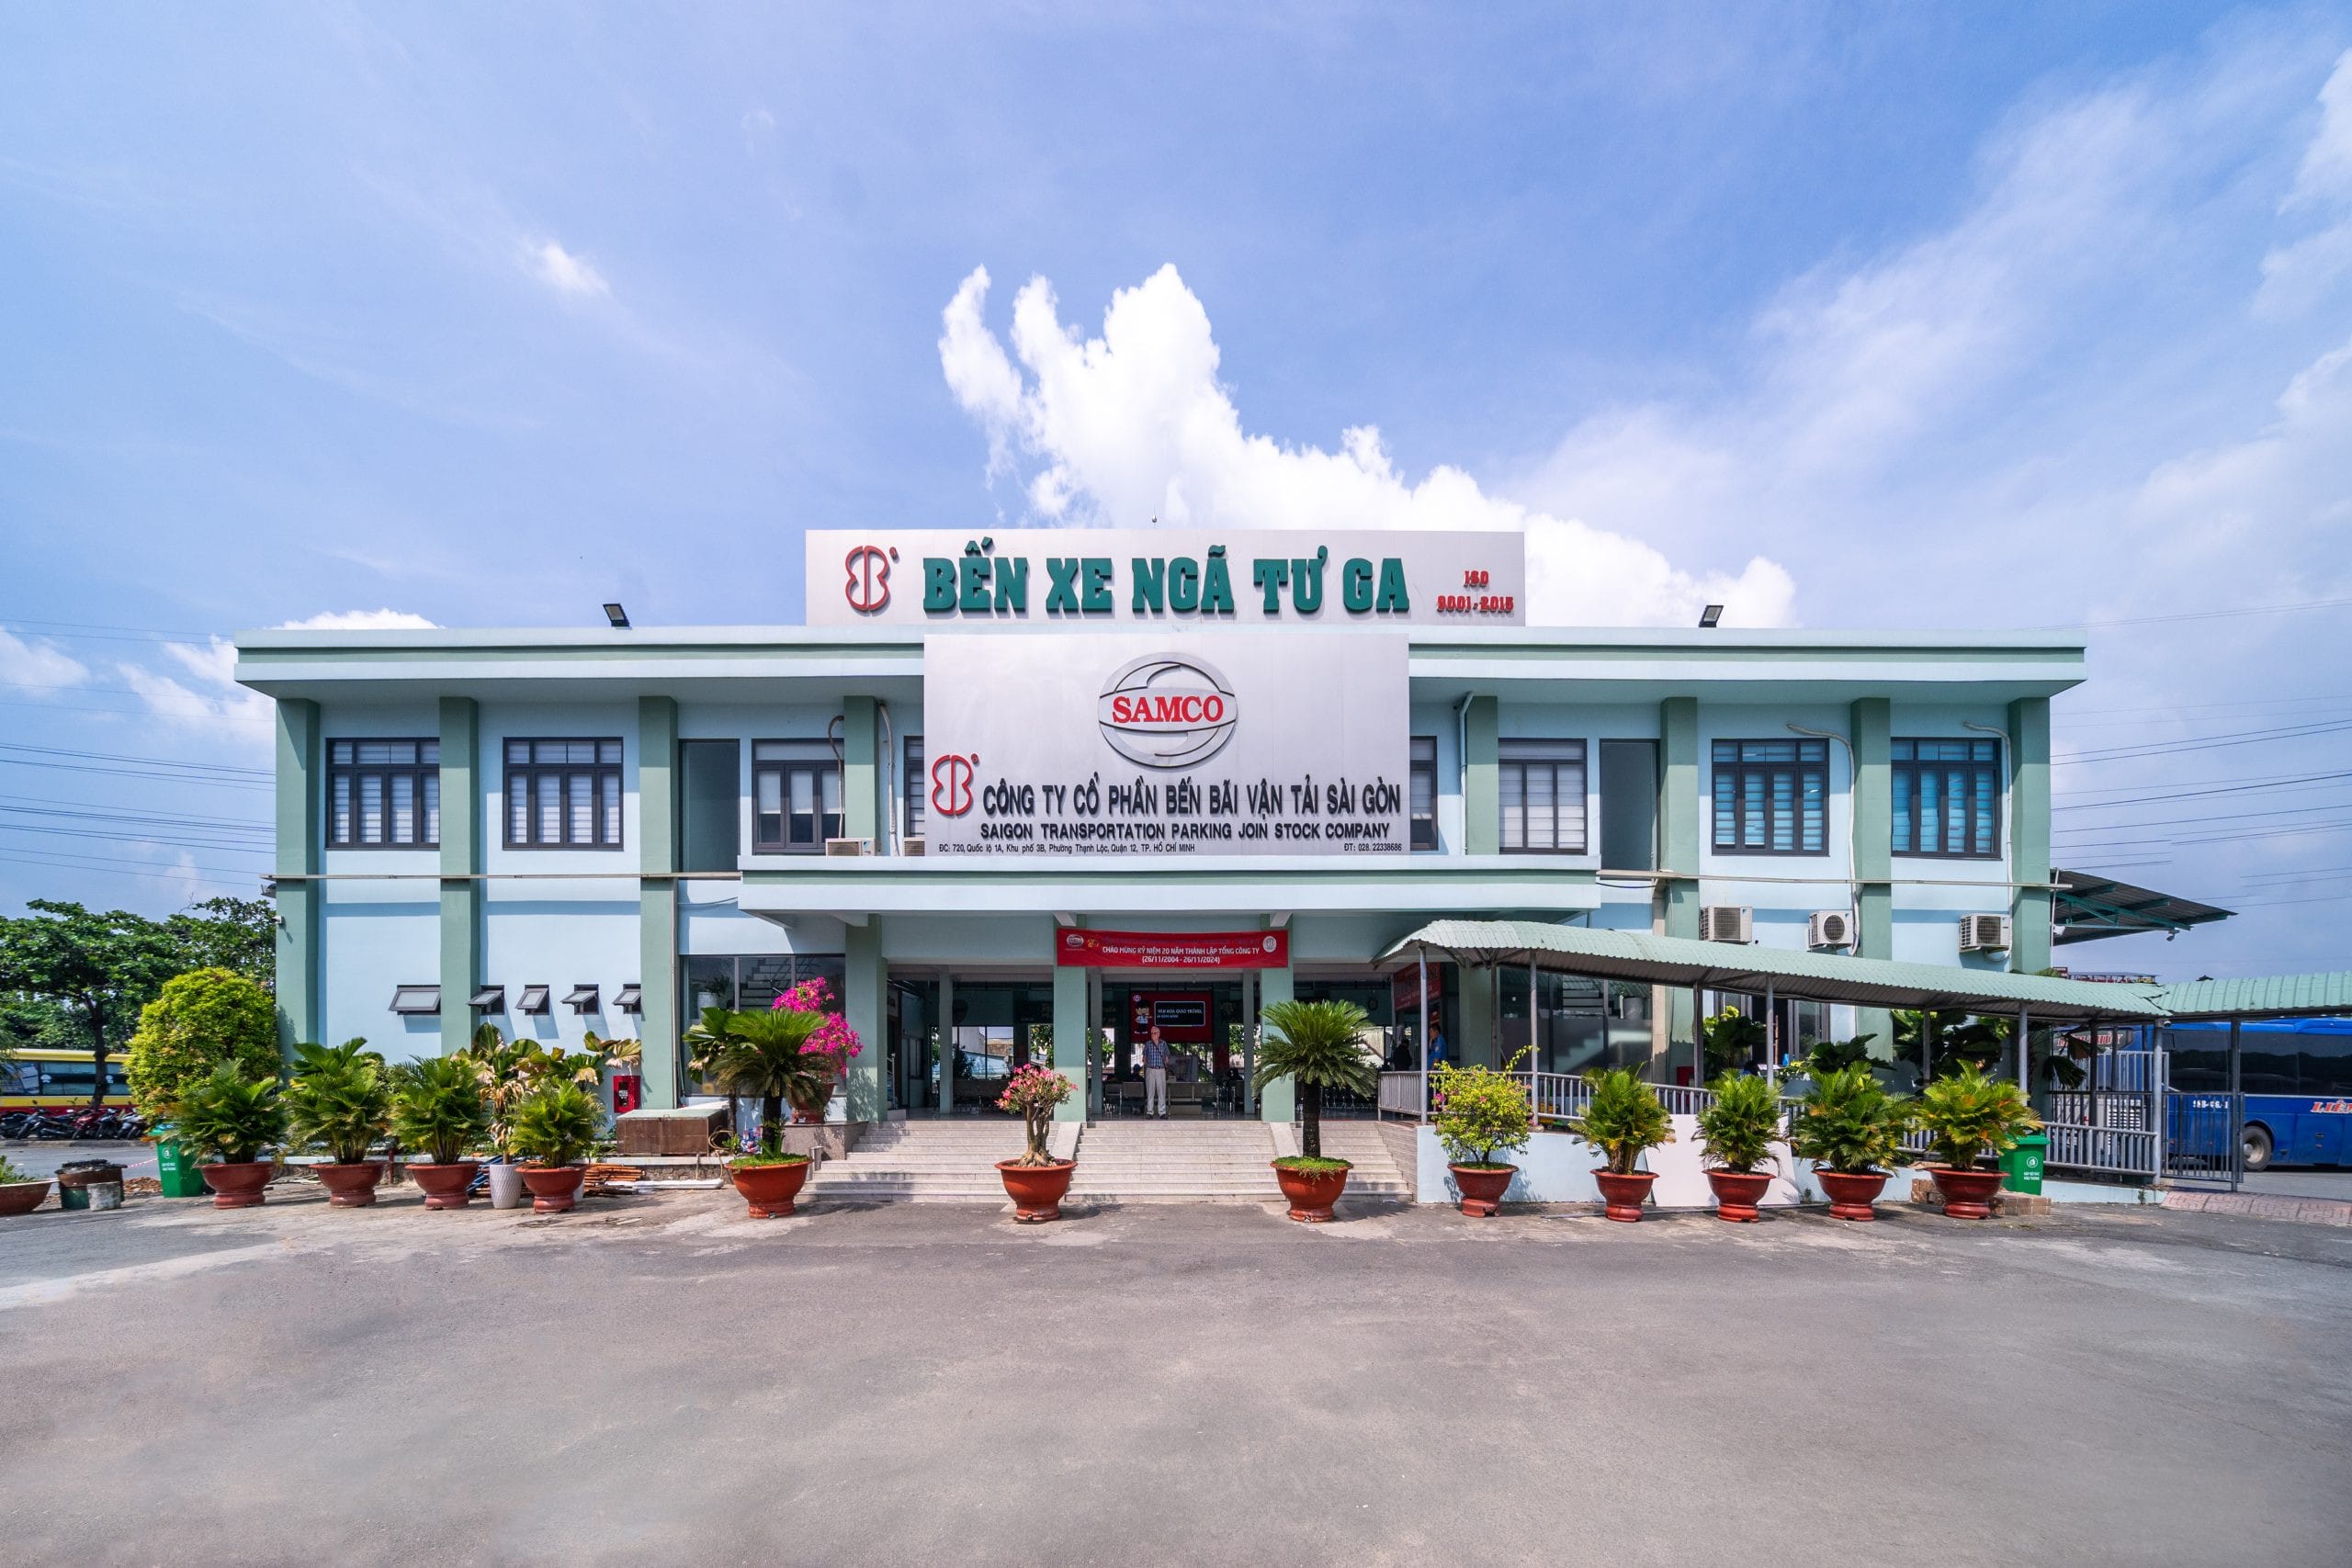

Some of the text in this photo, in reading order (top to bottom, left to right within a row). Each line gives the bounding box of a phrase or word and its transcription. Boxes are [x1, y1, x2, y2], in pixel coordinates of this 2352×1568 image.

[922, 536, 1410, 614] BẾN XE NGÃ TƯ GA
[1463, 570, 1489, 588] ISO
[1112, 694, 1224, 724] SAMCO
[983, 771, 1401, 819] CÔNG TY CỔ PHẦN BẾN BÃI VẬN TẢI SÀI GÒN
[980, 822, 1390, 840] SAIGON TRANSPORTATION PARKING JOIN STOCK COMPANY
[939, 843, 951, 852] ĐC:
[952, 843, 966, 854] 720,
[967, 843, 984, 853] Quốc
[1006, 843, 1019, 852] Khu
[1022, 842, 1035, 854] phố
[1141, 843, 1151, 852] TP.
[1165, 841, 1177, 852] CHÍ
[1179, 843, 1195, 852] MINH
[1343, 842, 1356, 852] ĐT:
[1252, 947, 1260, 955] TY
[2310, 1099, 2352, 1114] LIÊ
